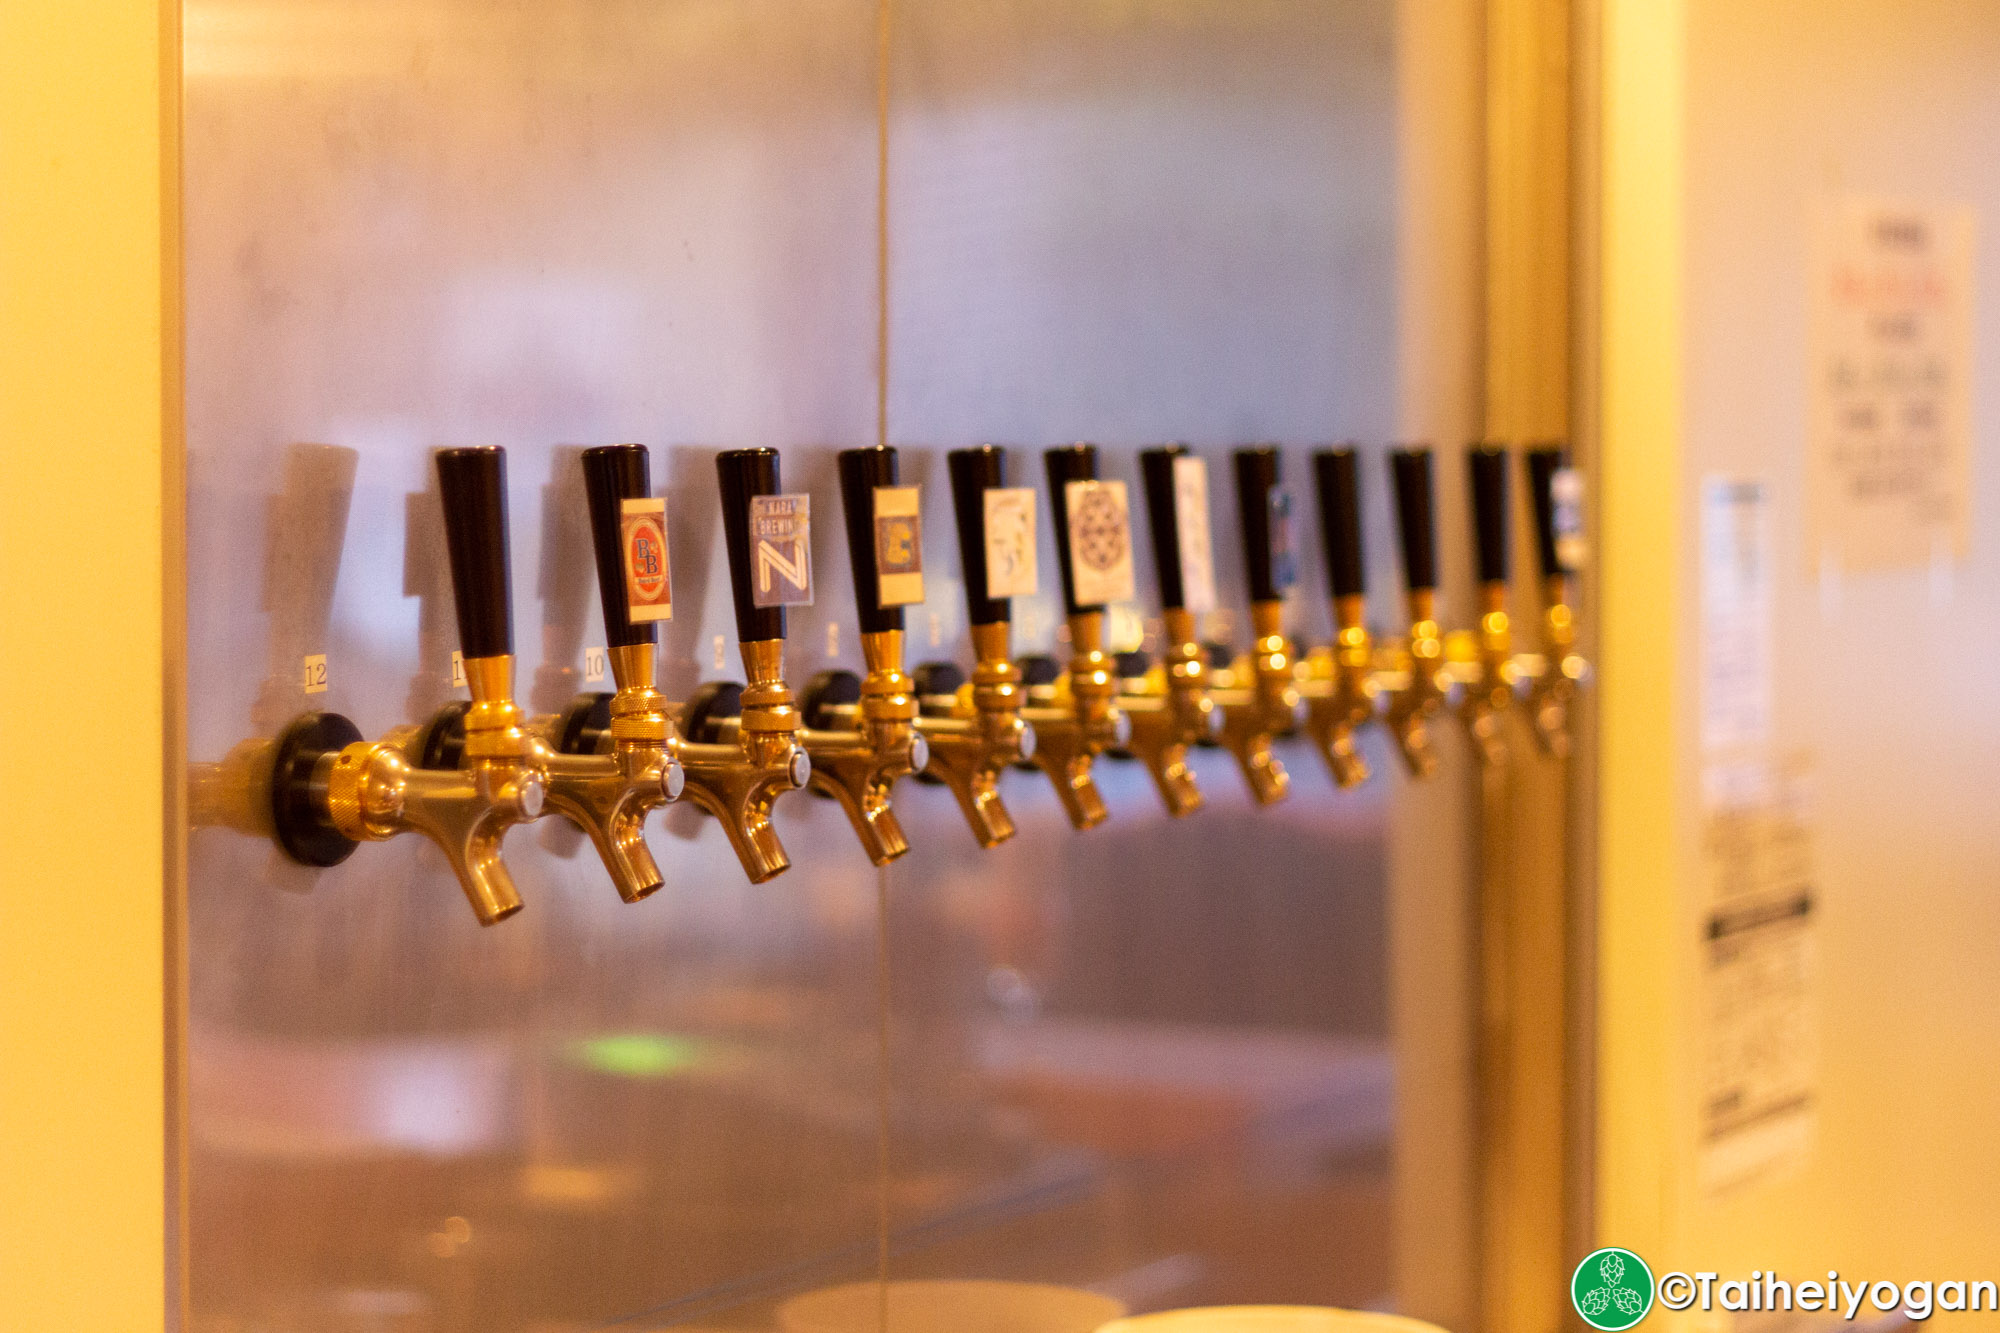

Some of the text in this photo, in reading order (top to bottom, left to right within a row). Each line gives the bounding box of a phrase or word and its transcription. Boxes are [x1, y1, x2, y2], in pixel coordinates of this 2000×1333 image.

[758, 539, 807, 593] N
[306, 663, 327, 687] 12
[587, 655, 604, 676] 10
